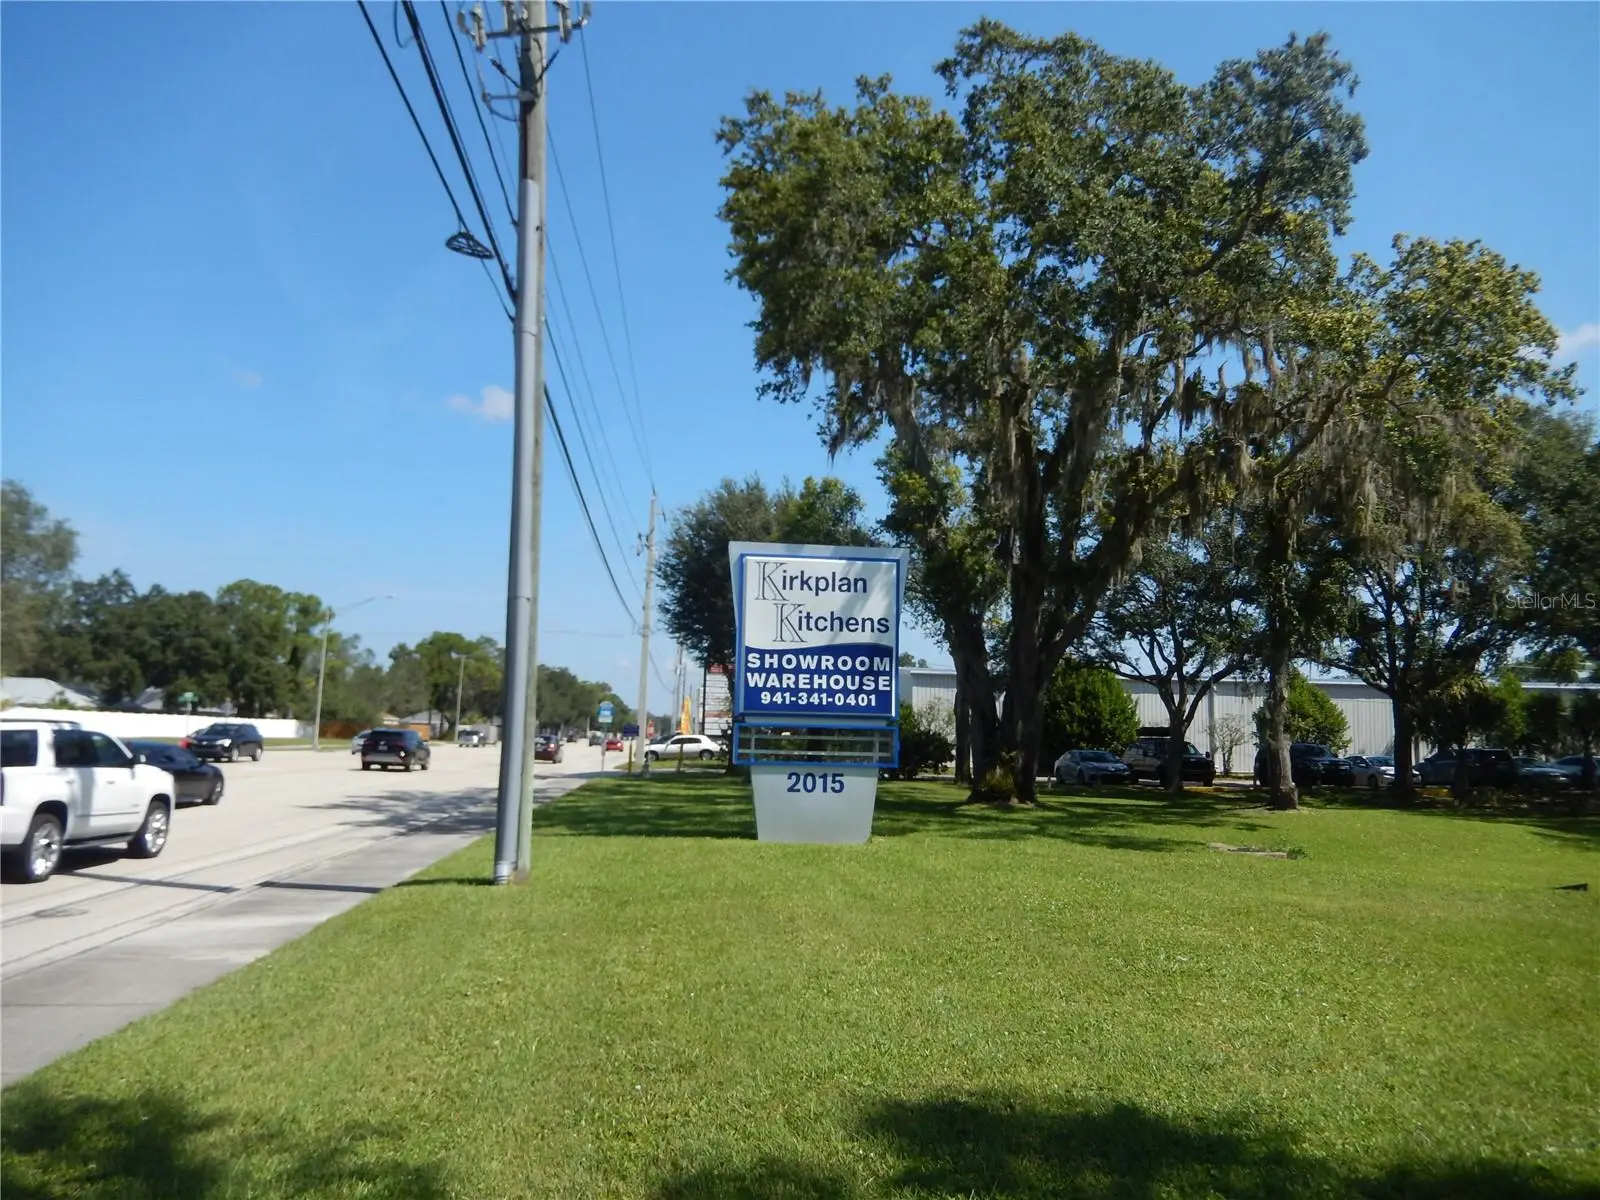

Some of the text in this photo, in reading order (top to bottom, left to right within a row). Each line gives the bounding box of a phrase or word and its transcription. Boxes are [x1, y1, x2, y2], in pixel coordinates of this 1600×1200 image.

[754, 561, 868, 601] Kirkplan
[772, 603, 890, 643] Kitchens
[747, 653, 891, 671] SHOWROOM
[746, 672, 891, 691] WAREHOUSE
[760, 691, 877, 707] 941-341-0401
[786, 772, 845, 794] 2015
